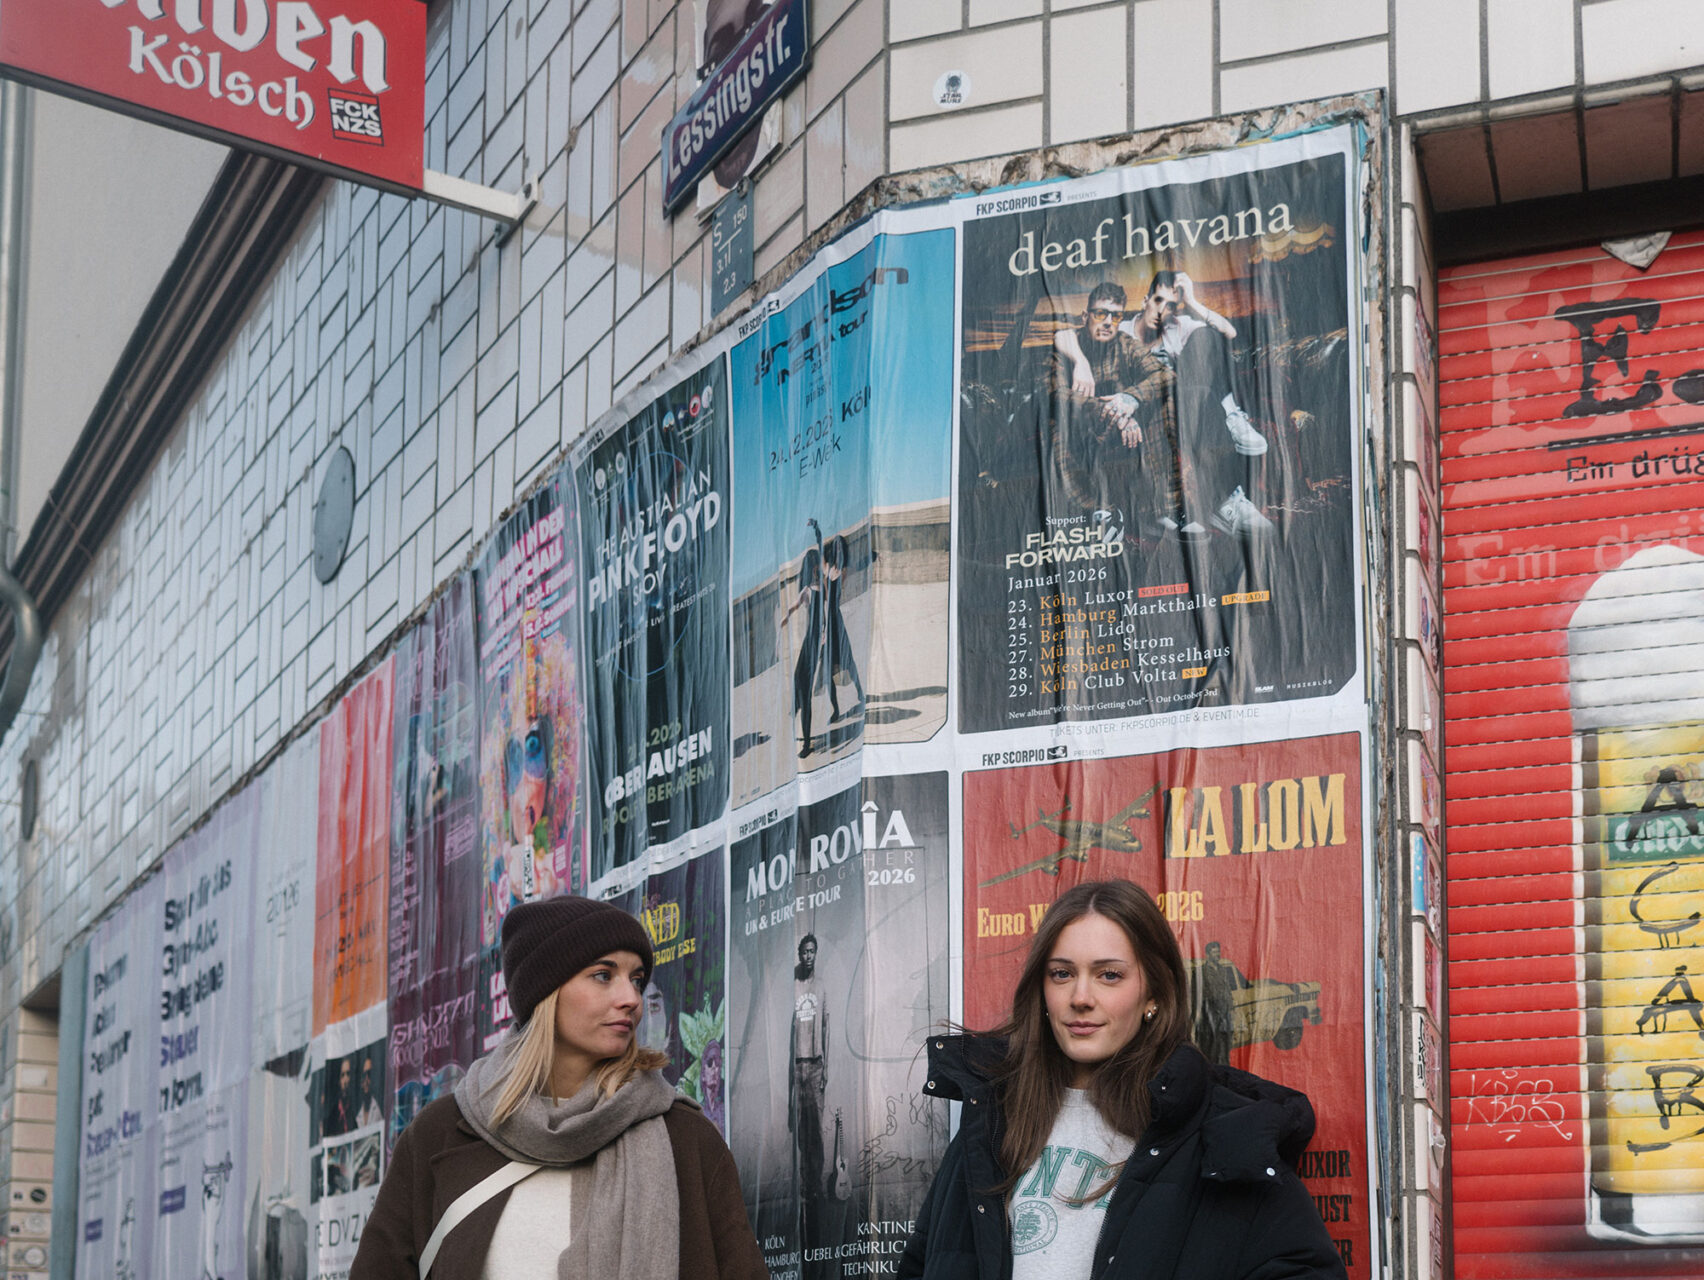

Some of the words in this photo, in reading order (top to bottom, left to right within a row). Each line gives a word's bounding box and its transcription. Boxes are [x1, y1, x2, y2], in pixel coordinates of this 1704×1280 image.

[127, 26, 316, 130] Kölsch
[330, 98, 379, 121] FCK
[666, 14, 792, 185] Lessingstr.
[331, 113, 383, 138] NZS
[732, 204, 748, 229] 150
[976, 202, 995, 217] FKP
[996, 195, 1038, 213] SCORPIO
[1008, 217, 1115, 277] deaf
[1122, 202, 1295, 260] havana
[838, 309, 869, 339] tour
[841, 385, 872, 423] Köl
[1566, 456, 1614, 483] Em
[1045, 515, 1087, 528] Support:
[1026, 525, 1102, 549] FLASH
[1005, 541, 1124, 570] FORWARD
[588, 543, 640, 613] PINK
[1008, 572, 1061, 593] Januar
[1067, 566, 1107, 583] 2026
[1008, 599, 1032, 614] 23.
[1040, 592, 1077, 610] Köln
[1085, 589, 1134, 605] Luxor
[1008, 616, 1033, 630] 24.
[1040, 608, 1117, 627] Hamburg
[1123, 593, 1217, 617] Markthalle
[1008, 633, 1033, 647] 25.
[1040, 625, 1090, 643] Berlin
[1097, 620, 1135, 638] Lido
[1008, 649, 1033, 664] 27.
[1040, 641, 1116, 661] München
[1123, 636, 1174, 651] Strom
[1008, 666, 1033, 681] 28.
[1040, 656, 1130, 677] Wiesbaden
[1137, 646, 1231, 667] Kesselhaus
[1008, 683, 1033, 698] 29.
[1040, 676, 1077, 694] Köln
[1084, 672, 1125, 690] Club
[1132, 668, 1177, 684] Volta
[1008, 711, 1026, 720] New
[1072, 703, 1095, 712] Never
[1097, 700, 1126, 711] Getting
[1155, 694, 1172, 704] Out
[1173, 690, 1203, 702] October
[1203, 687, 1218, 697] 3rd
[1193, 711, 1201, 722] &
[982, 753, 1001, 767] FKP
[1002, 748, 1045, 765] SCORPIO
[1165, 786, 1231, 860] LA
[1234, 772, 1348, 855] LOM
[758, 886, 793, 913] PLAC
[805, 874, 827, 891] TO
[758, 914, 768, 930] &
[770, 895, 805, 925] EUROE
[808, 884, 842, 910] TOUR
[867, 867, 916, 887] 2026
[1157, 890, 1204, 922] 2026
[977, 907, 1025, 938] EURO
[1299, 1150, 1352, 1178] UXOR
[1312, 1194, 1352, 1223] UST
[765, 1234, 786, 1250] KÖLN
[857, 1220, 916, 1236] KANTINE
[804, 1247, 833, 1262] UEBEL
[834, 1247, 841, 1259] &
[841, 1239, 907, 1258] GEFÄHRLIC
[842, 1260, 901, 1277] TECHNIKU
